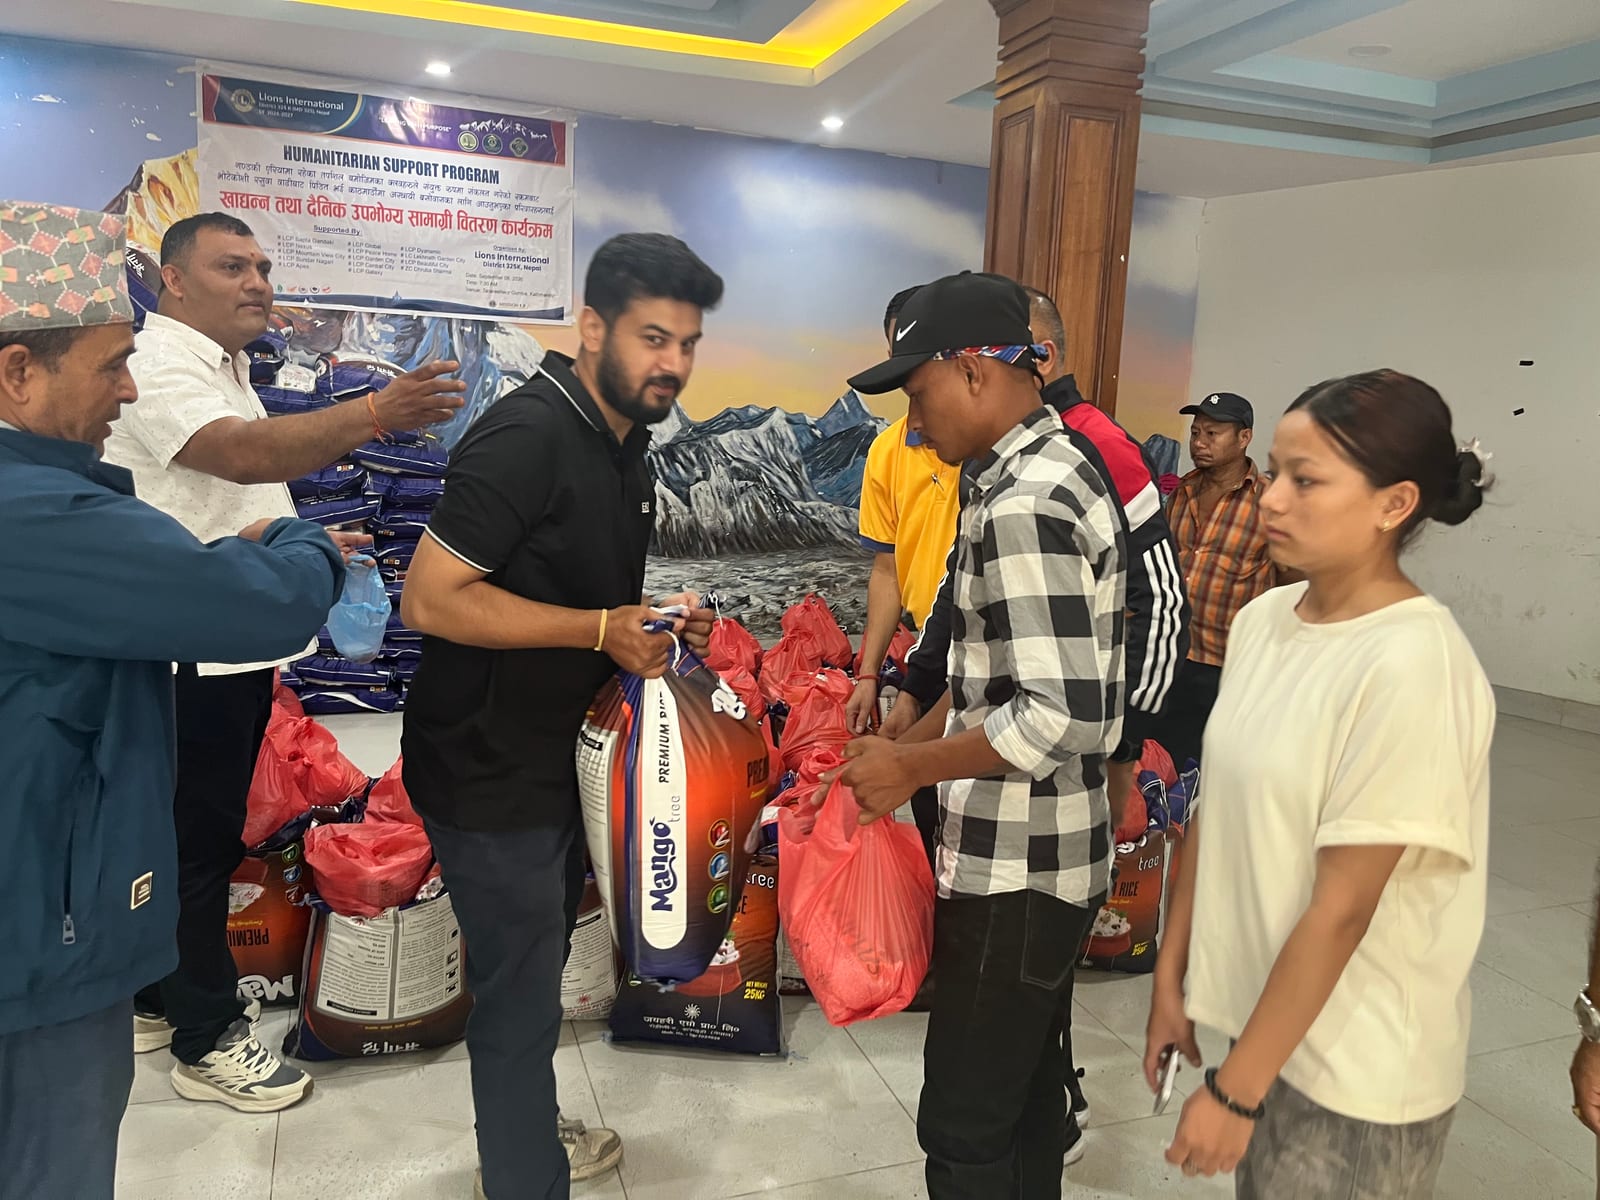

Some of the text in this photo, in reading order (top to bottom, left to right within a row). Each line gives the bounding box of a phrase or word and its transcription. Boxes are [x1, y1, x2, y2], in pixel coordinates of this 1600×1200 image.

[259, 92, 344, 111] Lions International
[283, 145, 500, 184] HUMANITARIAN SUPPORT PROGRAM
[275, 196, 302, 214] तथा
[307, 193, 347, 218] दैनिक
[351, 202, 404, 224] उपभोग्य
[408, 209, 453, 231] सामाग्री
[457, 210, 498, 234] वितरण
[501, 218, 553, 240] कार्यक्रम
[314, 225, 349, 235] Supported
[474, 251, 550, 265] Lions International
[524, 264, 542, 272] Nepal
[659, 724, 670, 784] PREMIUM
[669, 794, 680, 822] tree
[648, 815, 678, 912] Mango
[1119, 880, 1139, 896] RICE
[226, 928, 269, 947] PREMIU
[743, 988, 765, 1000] 25KG
